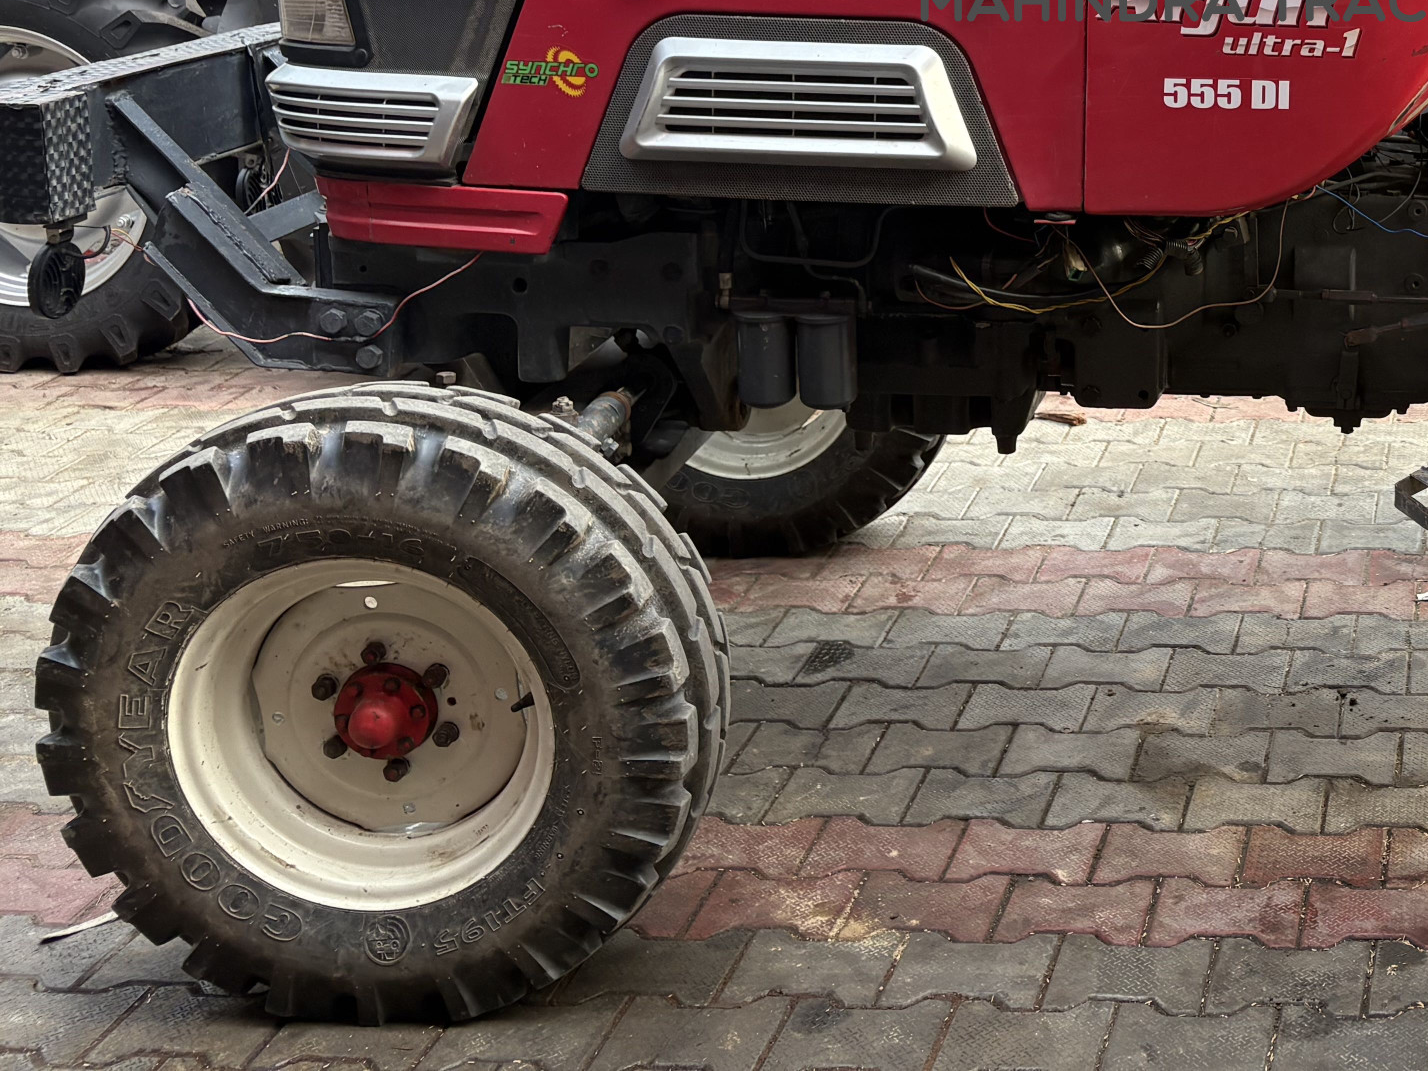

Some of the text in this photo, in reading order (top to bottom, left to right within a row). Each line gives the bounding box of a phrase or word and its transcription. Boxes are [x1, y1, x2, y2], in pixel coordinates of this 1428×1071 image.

[1222, 28, 1362, 59] ultra-1
[1163, 77, 1290, 110] 555 DI
[223, 530, 255, 548] SAFETY
[117, 599, 304, 941] GOODYEAR
[433, 877, 546, 956] FT195
